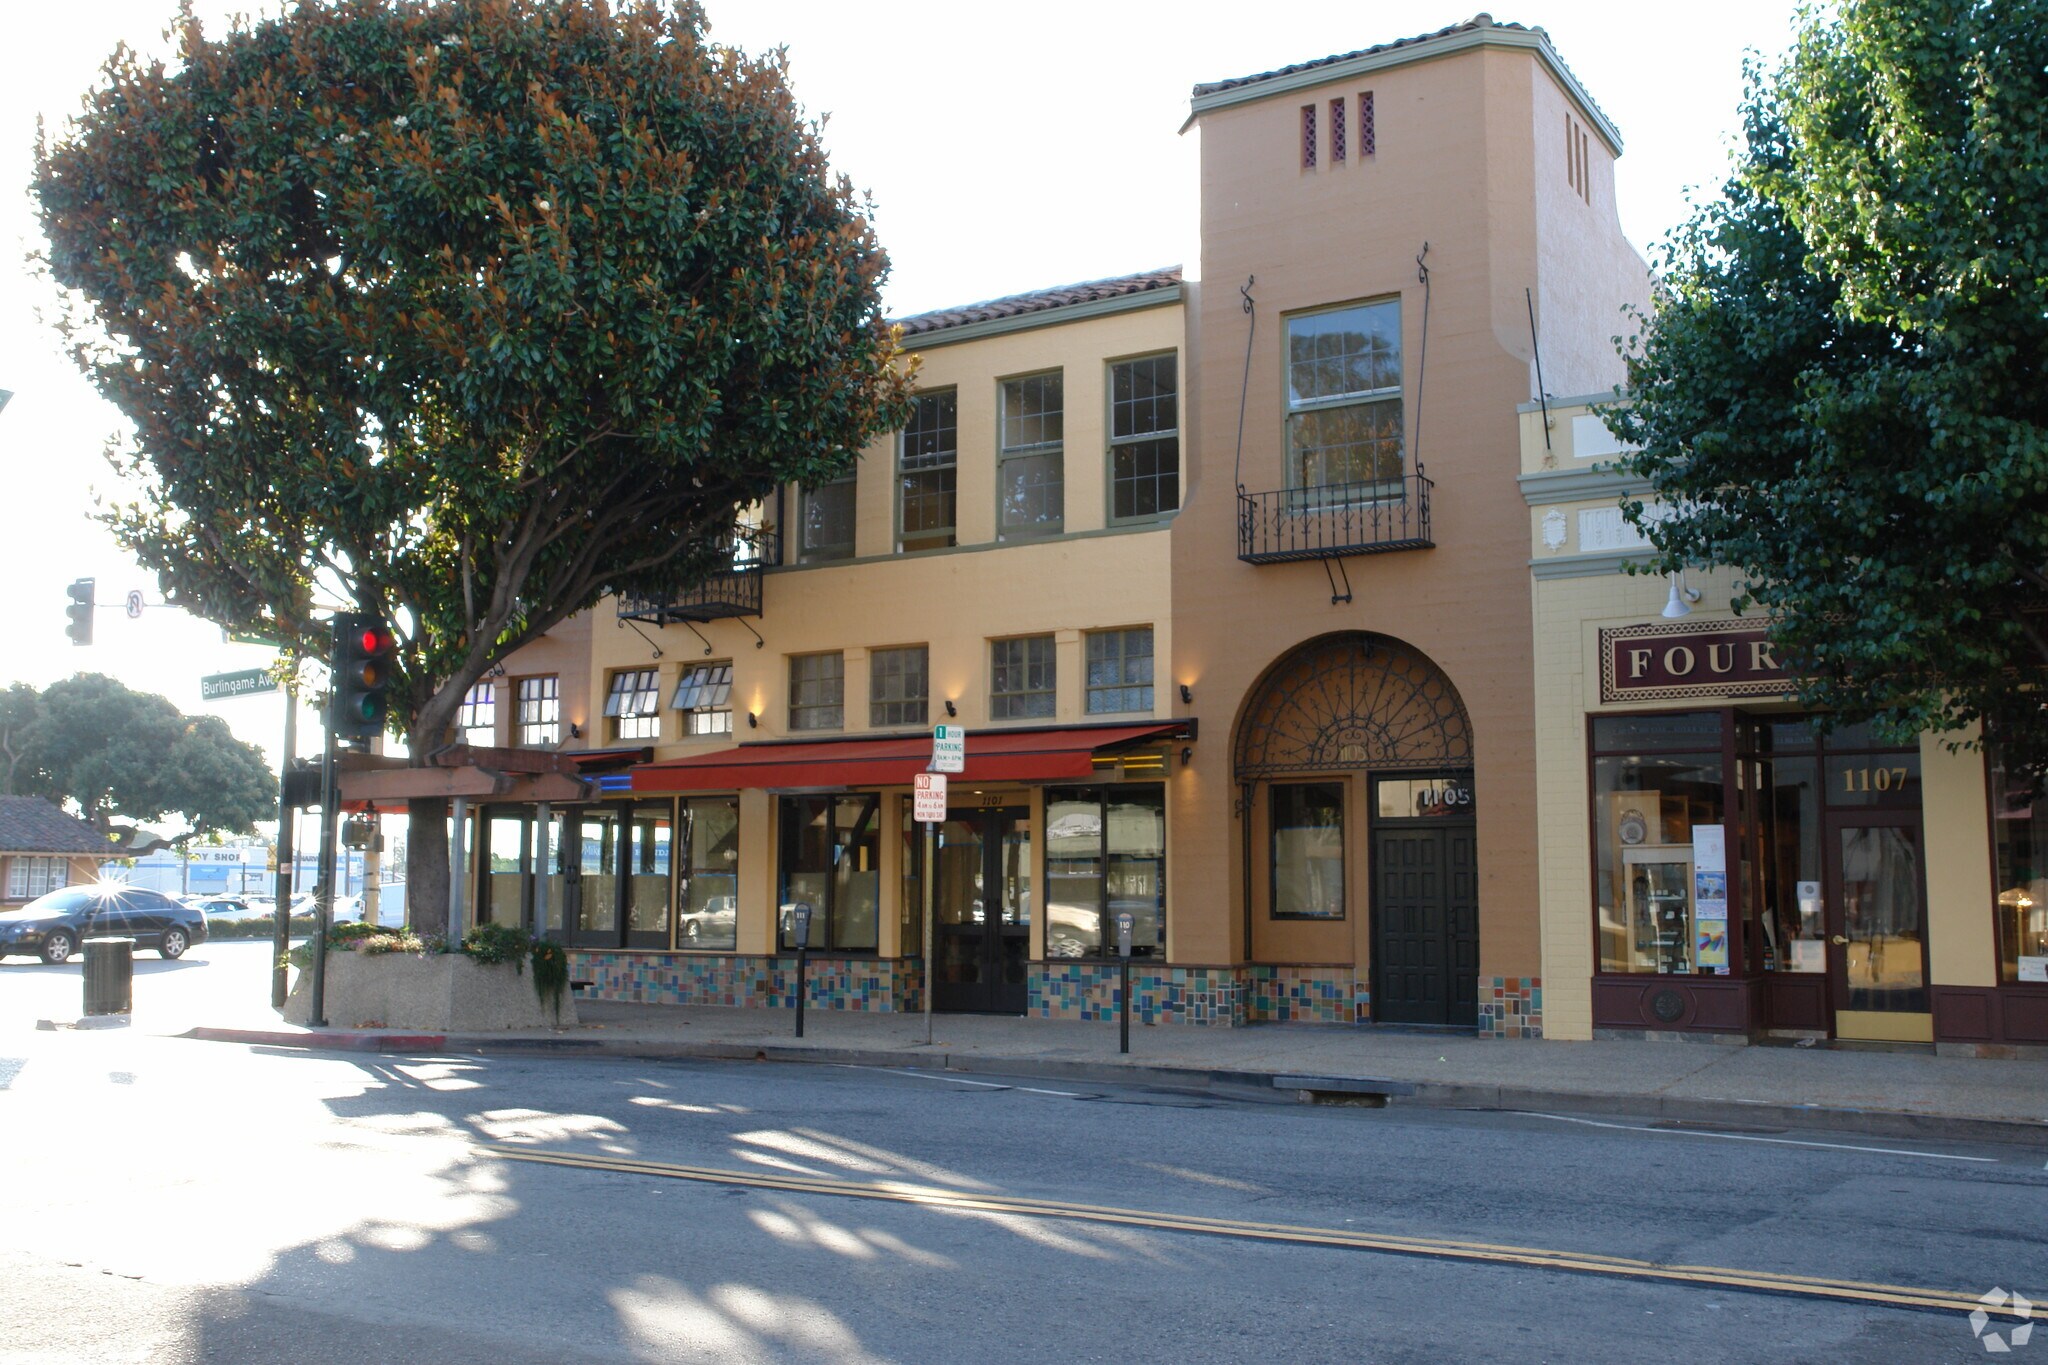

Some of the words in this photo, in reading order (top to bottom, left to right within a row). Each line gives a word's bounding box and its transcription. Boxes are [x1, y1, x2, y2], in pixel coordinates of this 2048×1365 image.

[1628, 641, 1780, 679] FOUR
[203, 677, 255, 695] Burlingame
[947, 730, 961, 738] HOUR
[936, 742, 962, 752] PARKING
[917, 776, 929, 789] NO
[1843, 767, 1908, 792] 1107
[917, 790, 944, 800] PARKING
[983, 796, 1002, 805] 1101
[1423, 787, 1470, 805] 1105
